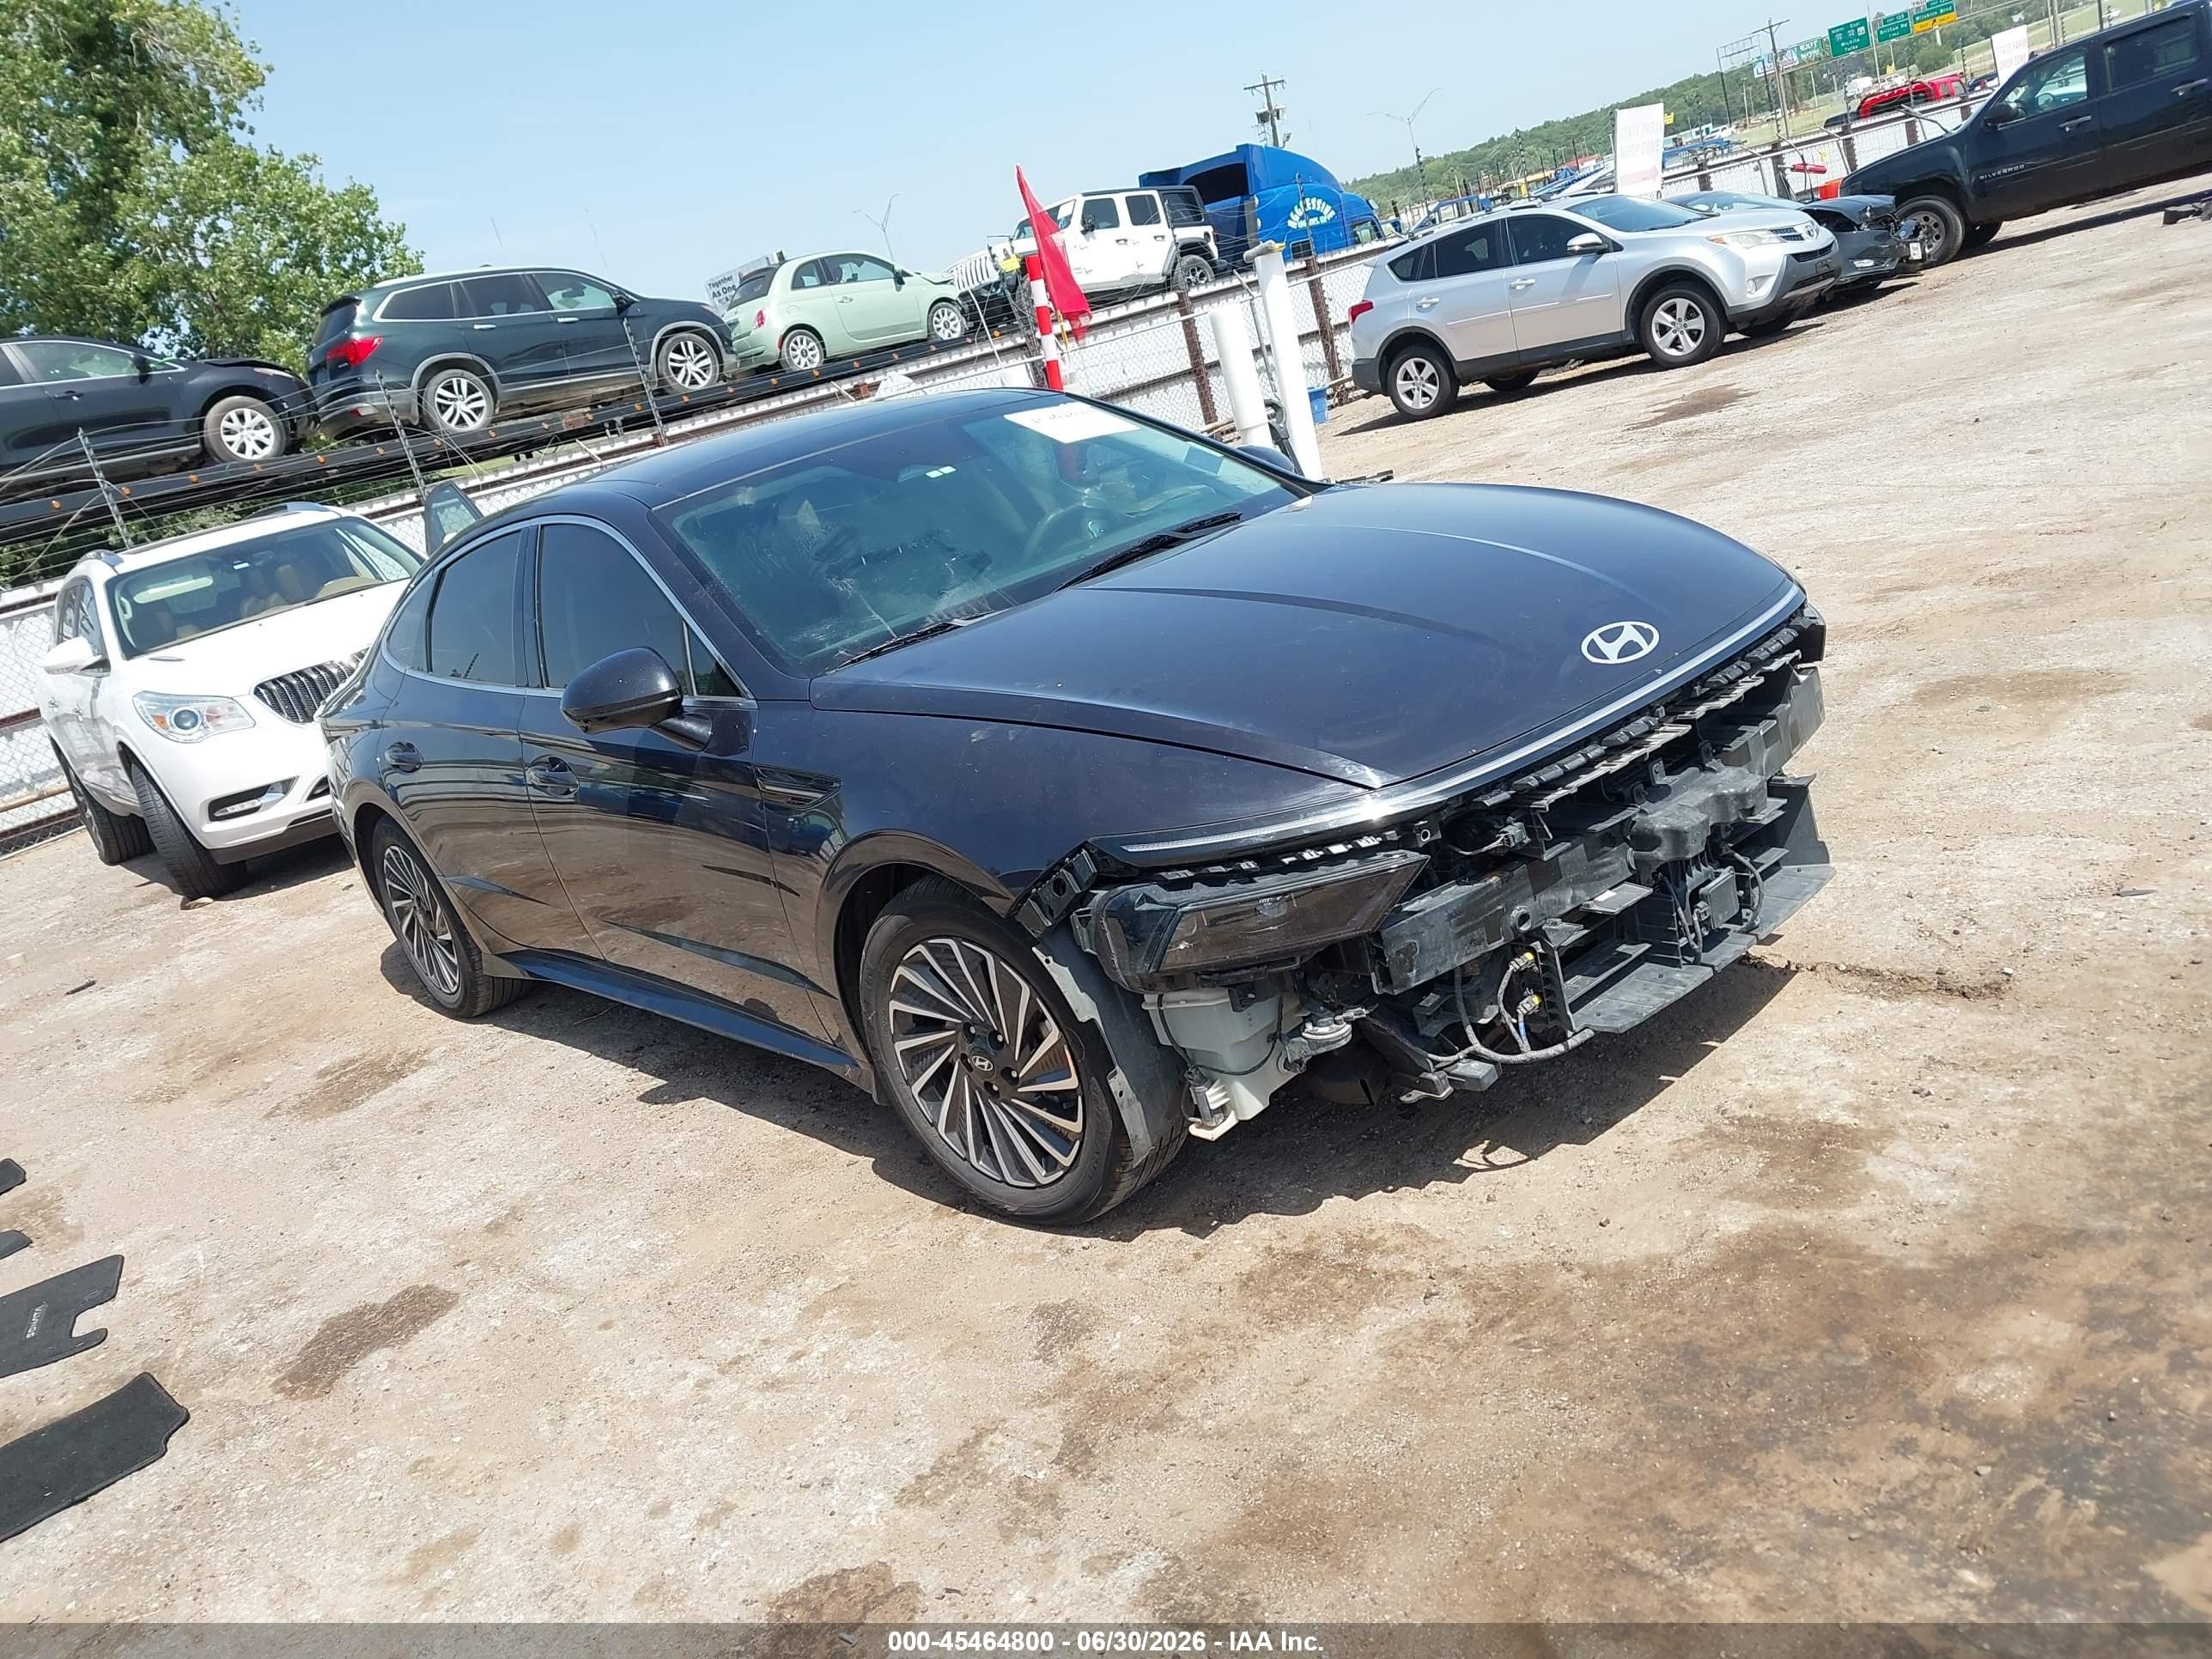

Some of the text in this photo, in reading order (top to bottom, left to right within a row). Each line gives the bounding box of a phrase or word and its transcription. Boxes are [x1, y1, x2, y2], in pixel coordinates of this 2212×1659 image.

[1916, 10, 1937, 21] Wilshire
[1799, 40, 1818, 51] EXIT
[1841, 38, 1860, 47] Wichita
[1978, 164, 2025, 180] SILVERADO
[708, 275, 732, 289] Together
[712, 283, 737, 299] As One
[26, 1304, 44, 1339] SONATA
